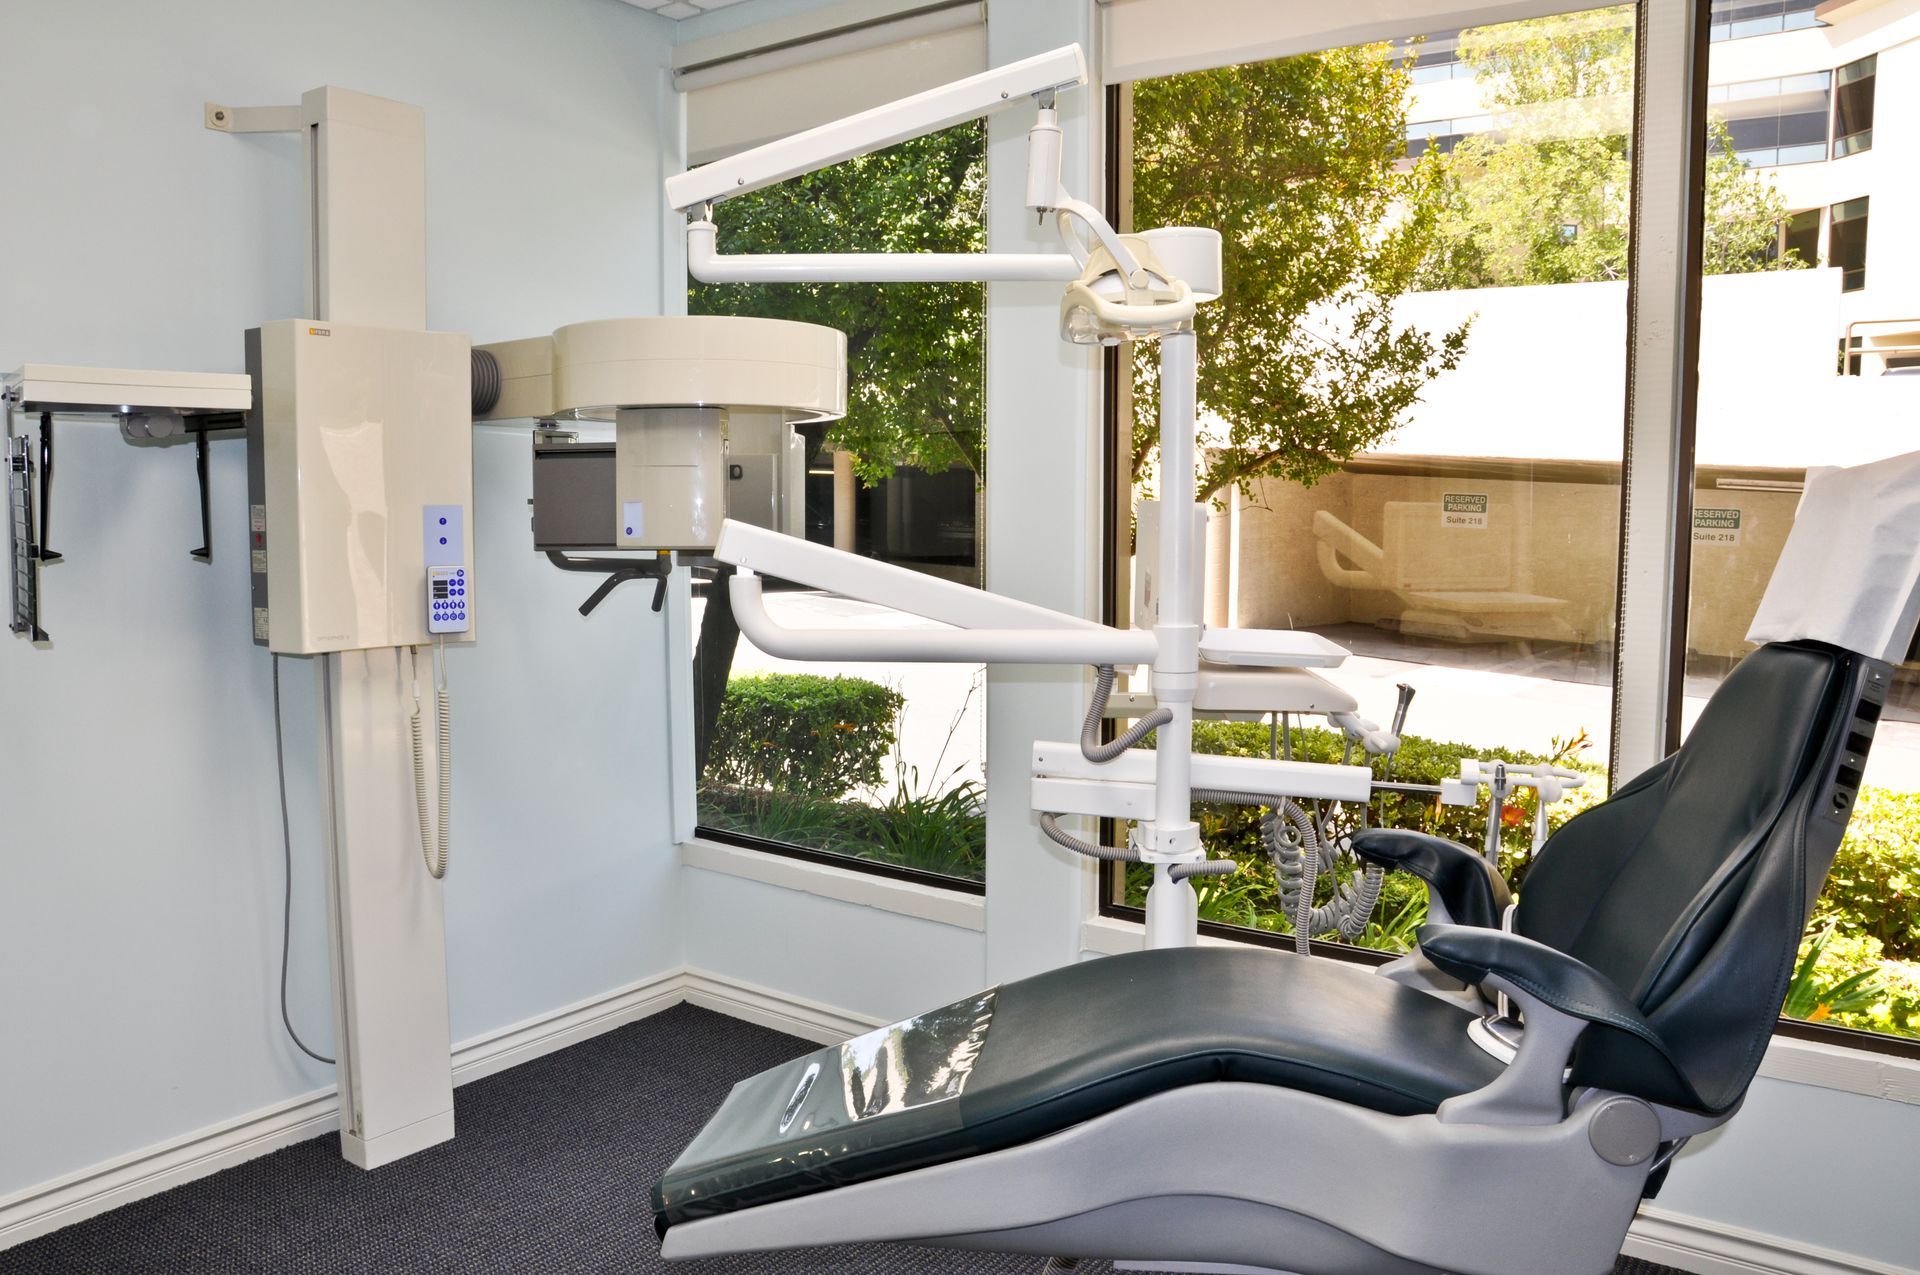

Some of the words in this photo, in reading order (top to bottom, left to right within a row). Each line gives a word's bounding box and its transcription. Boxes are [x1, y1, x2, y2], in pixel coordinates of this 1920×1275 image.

[1445, 495, 1486, 504] RESERVED
[1447, 503, 1482, 512] PARKING
[1446, 516, 1466, 524] Suite
[1468, 517, 1482, 525] 218
[1695, 519, 1735, 528] PARKING
[1693, 532, 1716, 541] Suite
[1719, 534, 1735, 542] 218
